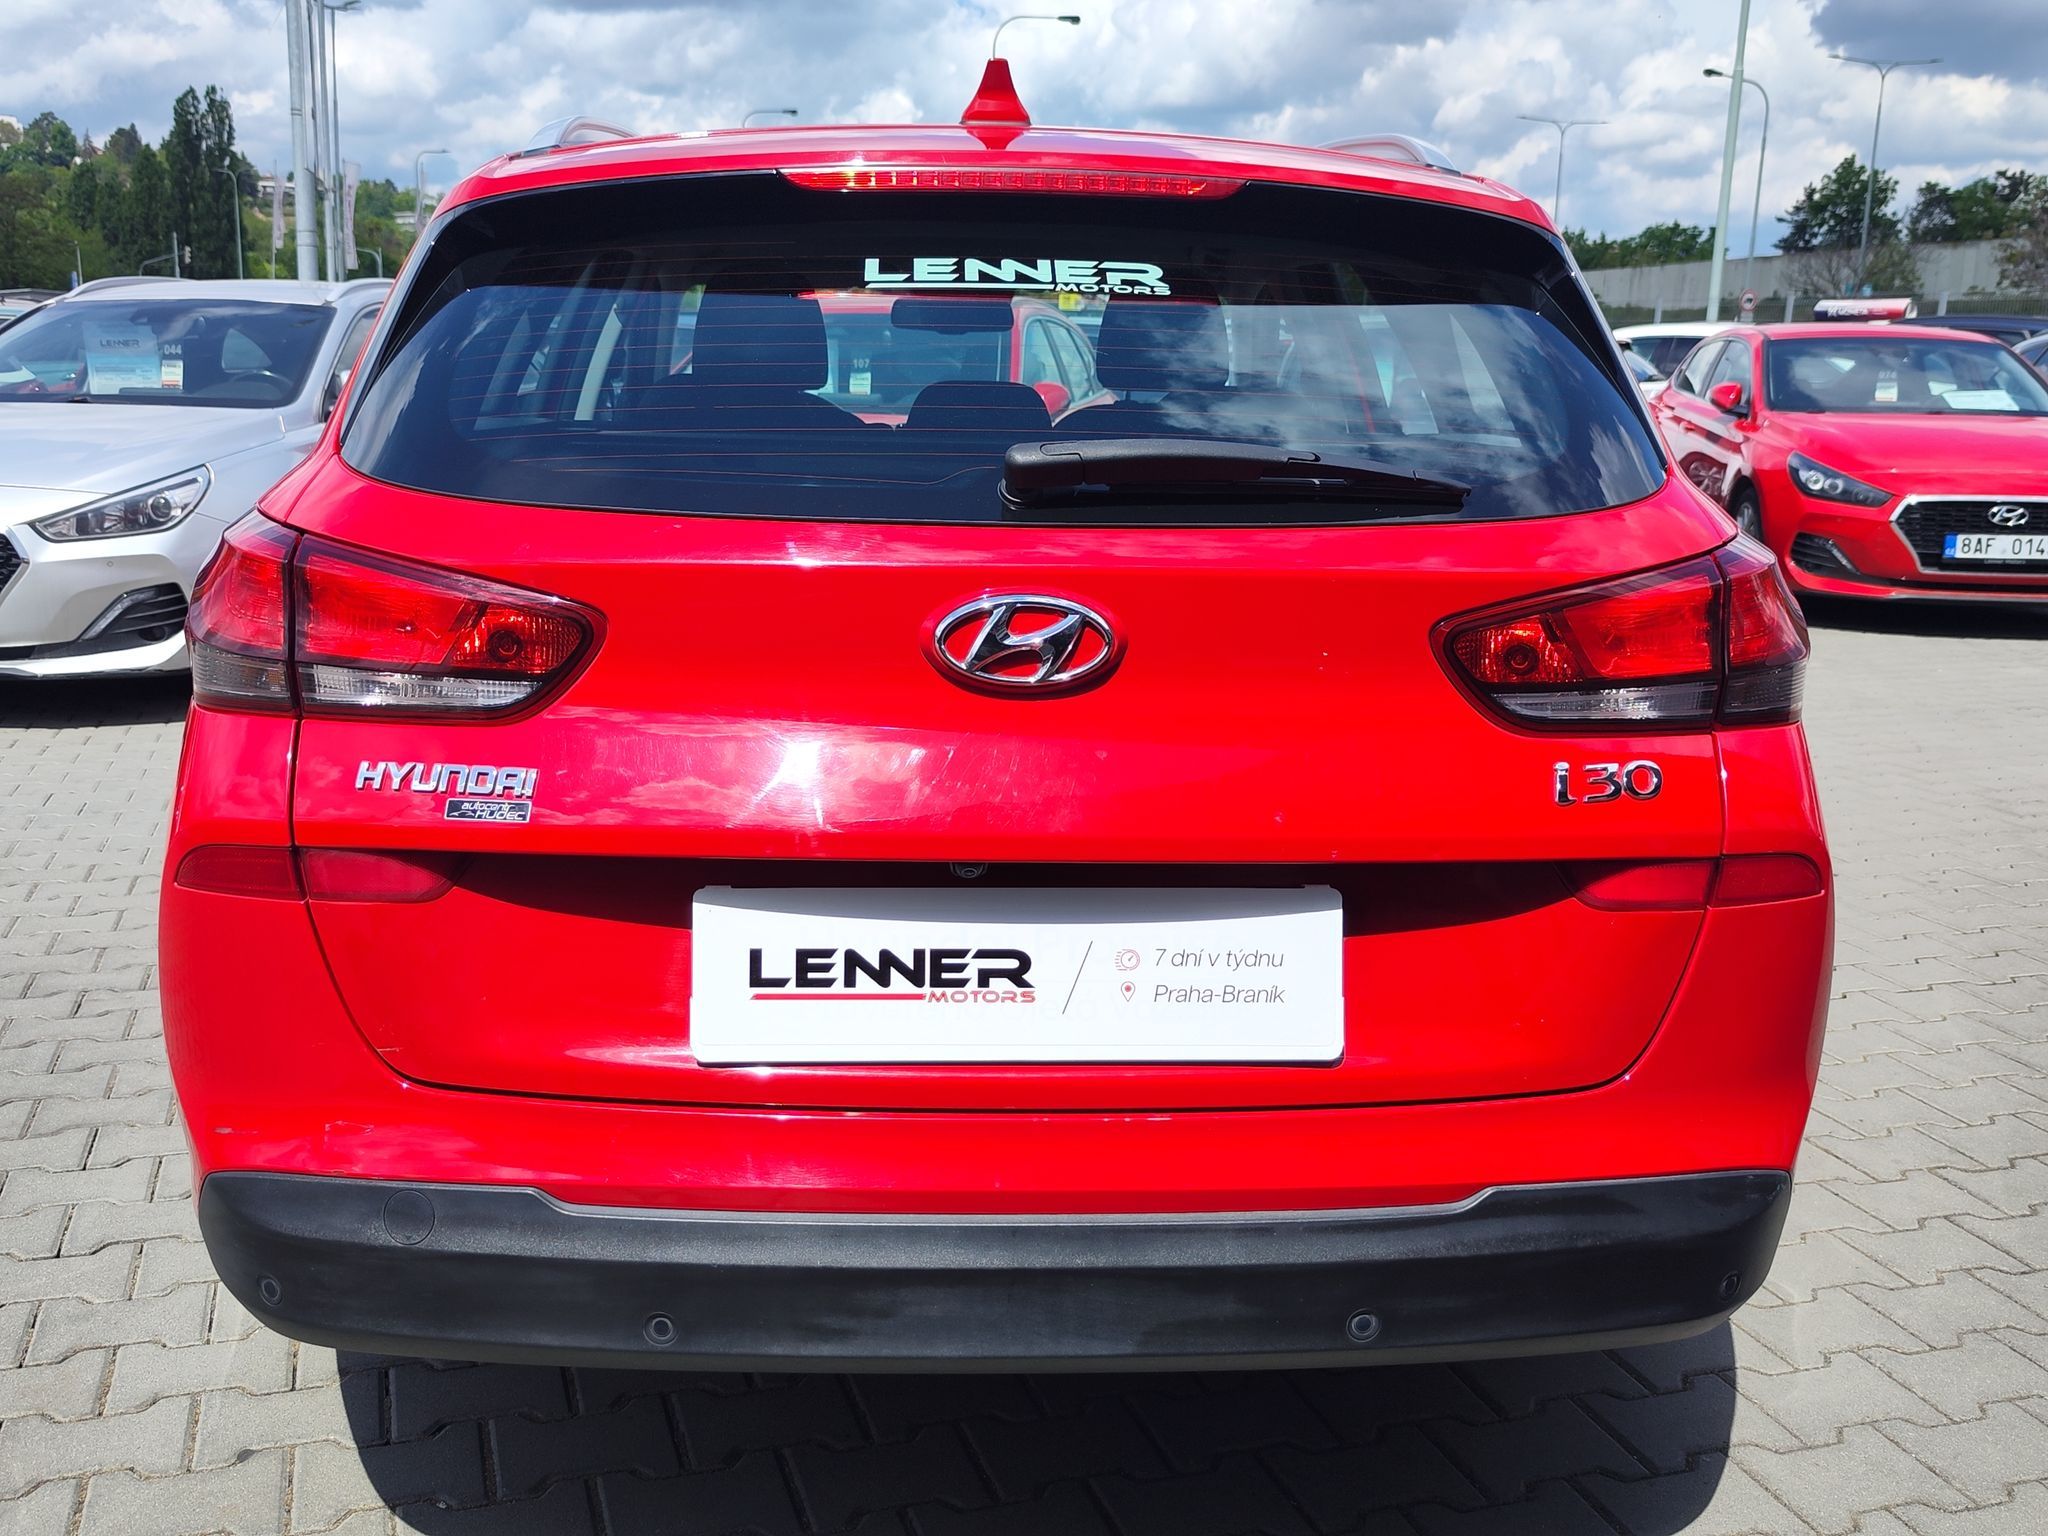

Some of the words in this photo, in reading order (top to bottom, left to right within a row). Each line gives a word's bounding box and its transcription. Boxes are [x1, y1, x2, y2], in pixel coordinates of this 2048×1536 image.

[864, 258, 1168, 287] LENNER
[1055, 283, 1171, 295] MOTORS
[164, 344, 182, 355] 044
[853, 358, 870, 369] 107
[1961, 538, 1996, 554] 8AF
[355, 761, 539, 799] HYUNDAI
[749, 948, 1035, 988] LENNER
[1155, 948, 1167, 967] 7
[1171, 948, 1204, 967] dní
[1208, 952, 1220, 967] v
[1226, 948, 1284, 972] týdnu
[927, 990, 1036, 1004] MOTORS
[1154, 984, 1286, 1003] Praha-Braník
